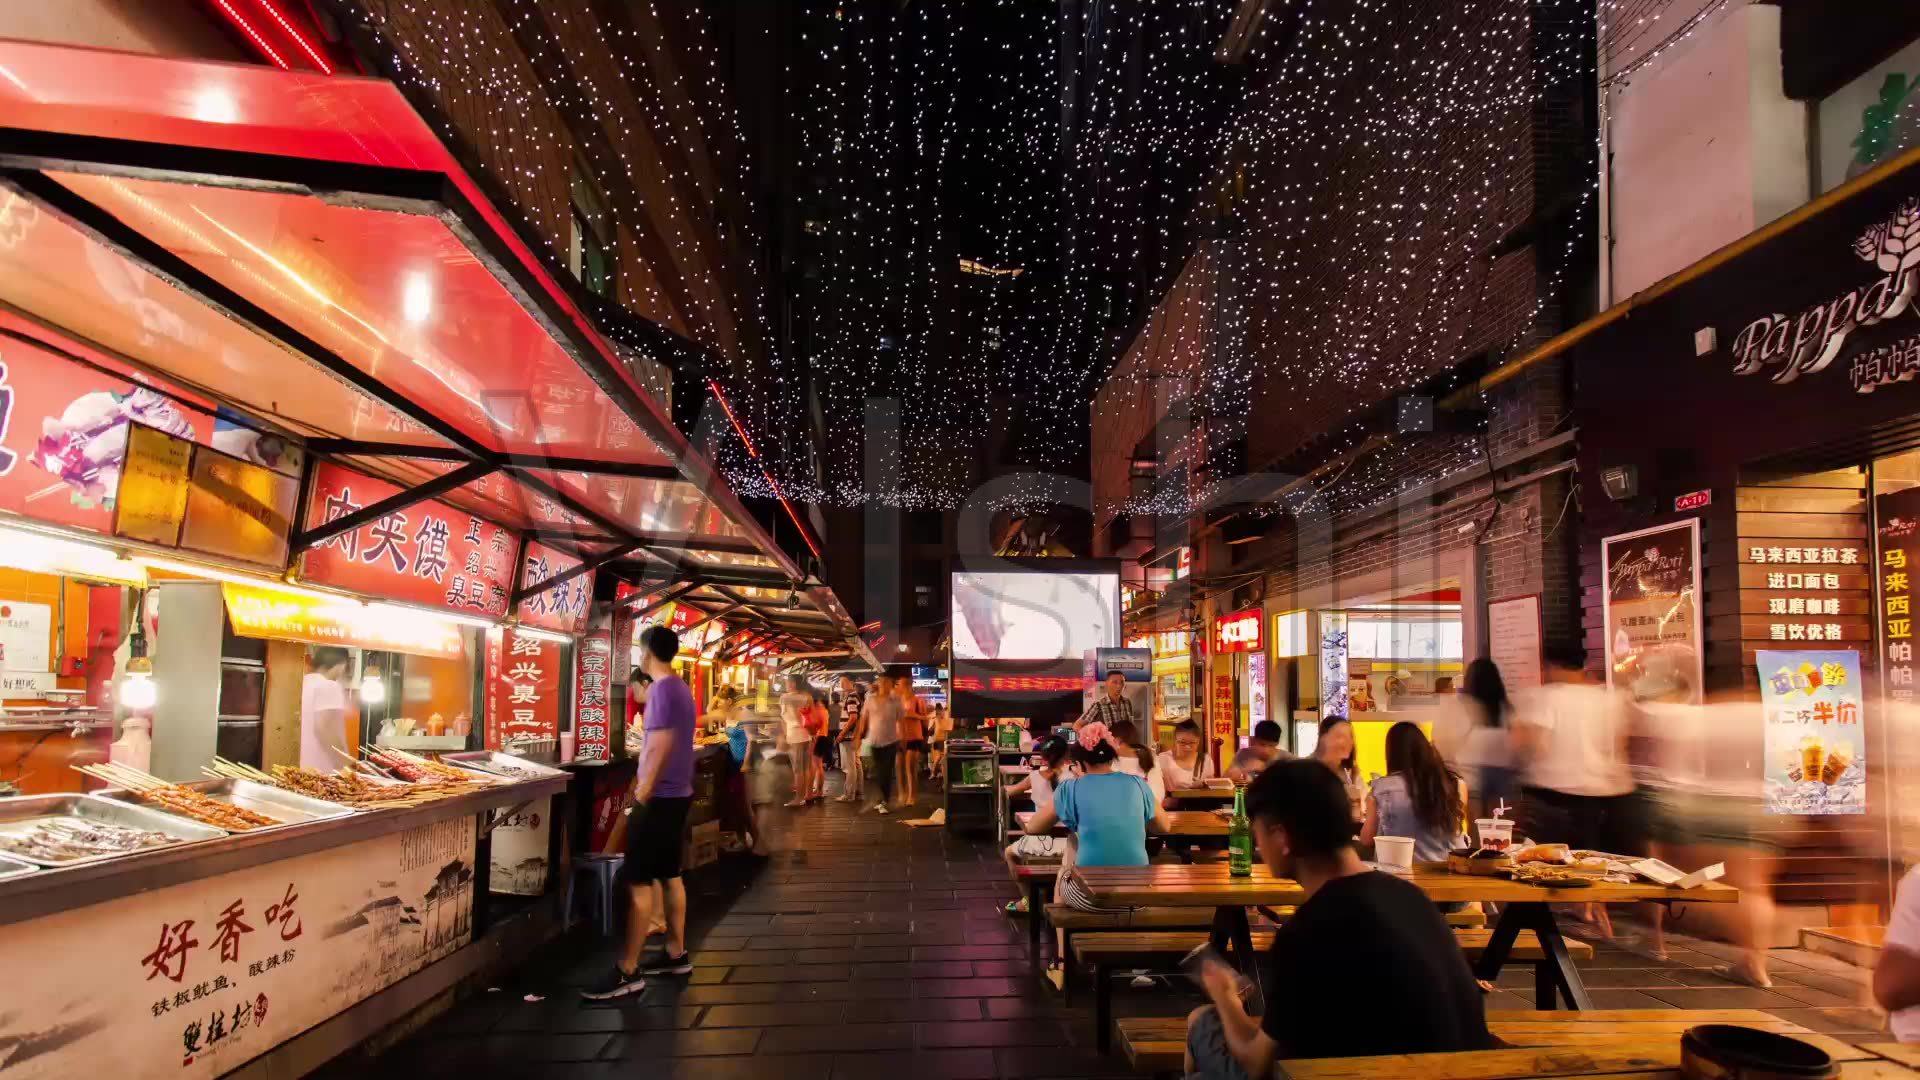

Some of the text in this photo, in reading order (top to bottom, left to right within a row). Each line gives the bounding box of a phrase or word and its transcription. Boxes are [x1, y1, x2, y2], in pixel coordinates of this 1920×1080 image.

[1732, 272, 1902, 384] Pappa
[315, 486, 449, 583] 肉夹馍
[464, 516, 510, 553] 正宗
[465, 551, 498, 580] 绍兴
[1749, 546, 1858, 565] 马来西亚拉茶
[446, 575, 506, 614] 臭豆腐
[524, 556, 593, 620] 酸辣粉
[1767, 572, 1840, 590] 进口面包
[1768, 598, 1841, 615] 现磨咖啡
[1769, 623, 1842, 641] 雪饮优格
[578, 636, 607, 760] 正宗重庆酸辣粉
[141, 883, 303, 983] 好香吃
[248, 948, 297, 978] 酸辣粉
